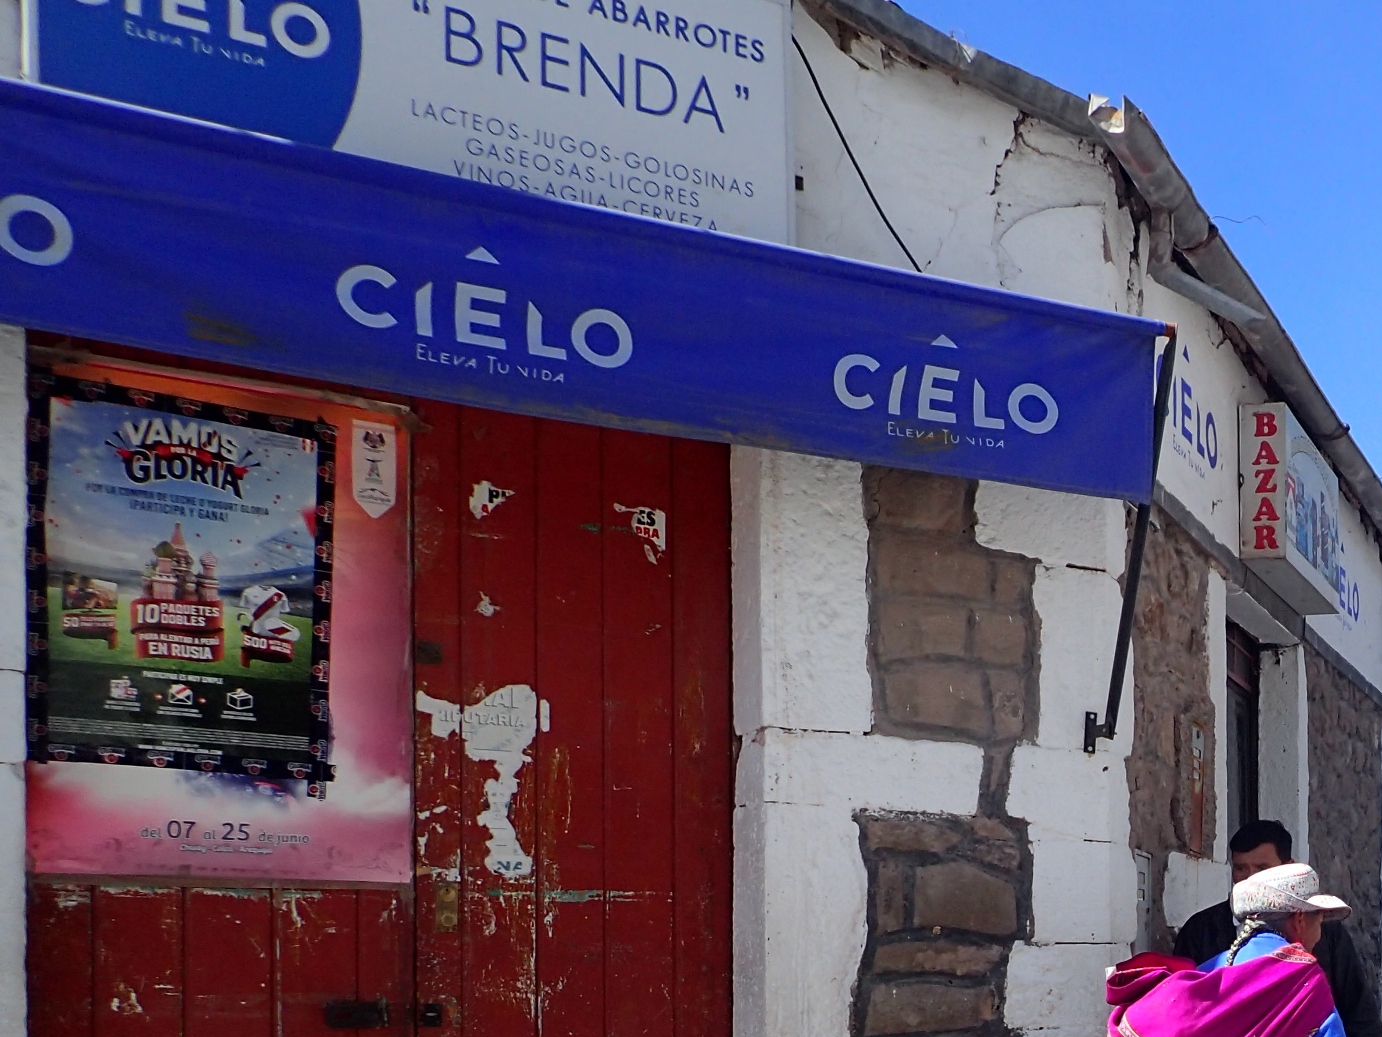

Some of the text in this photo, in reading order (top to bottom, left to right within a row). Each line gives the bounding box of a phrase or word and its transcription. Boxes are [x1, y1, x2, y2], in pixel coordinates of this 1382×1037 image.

[75, 0, 332, 58] ELO
[121, 417, 240, 461] VAMOS
[125, 448, 243, 500] GLORIA
[1252, 412, 1280, 551] BAZAR
[137, 603, 220, 624] 10 PAQUETES
[160, 613, 206, 627] DOBLES
[148, 641, 213, 660] EN RUSIA
[141, 827, 161, 839] del
[167, 820, 196, 839] 07
[203, 830, 216, 840] al
[221, 822, 250, 841] 25
[258, 831, 273, 842] de
